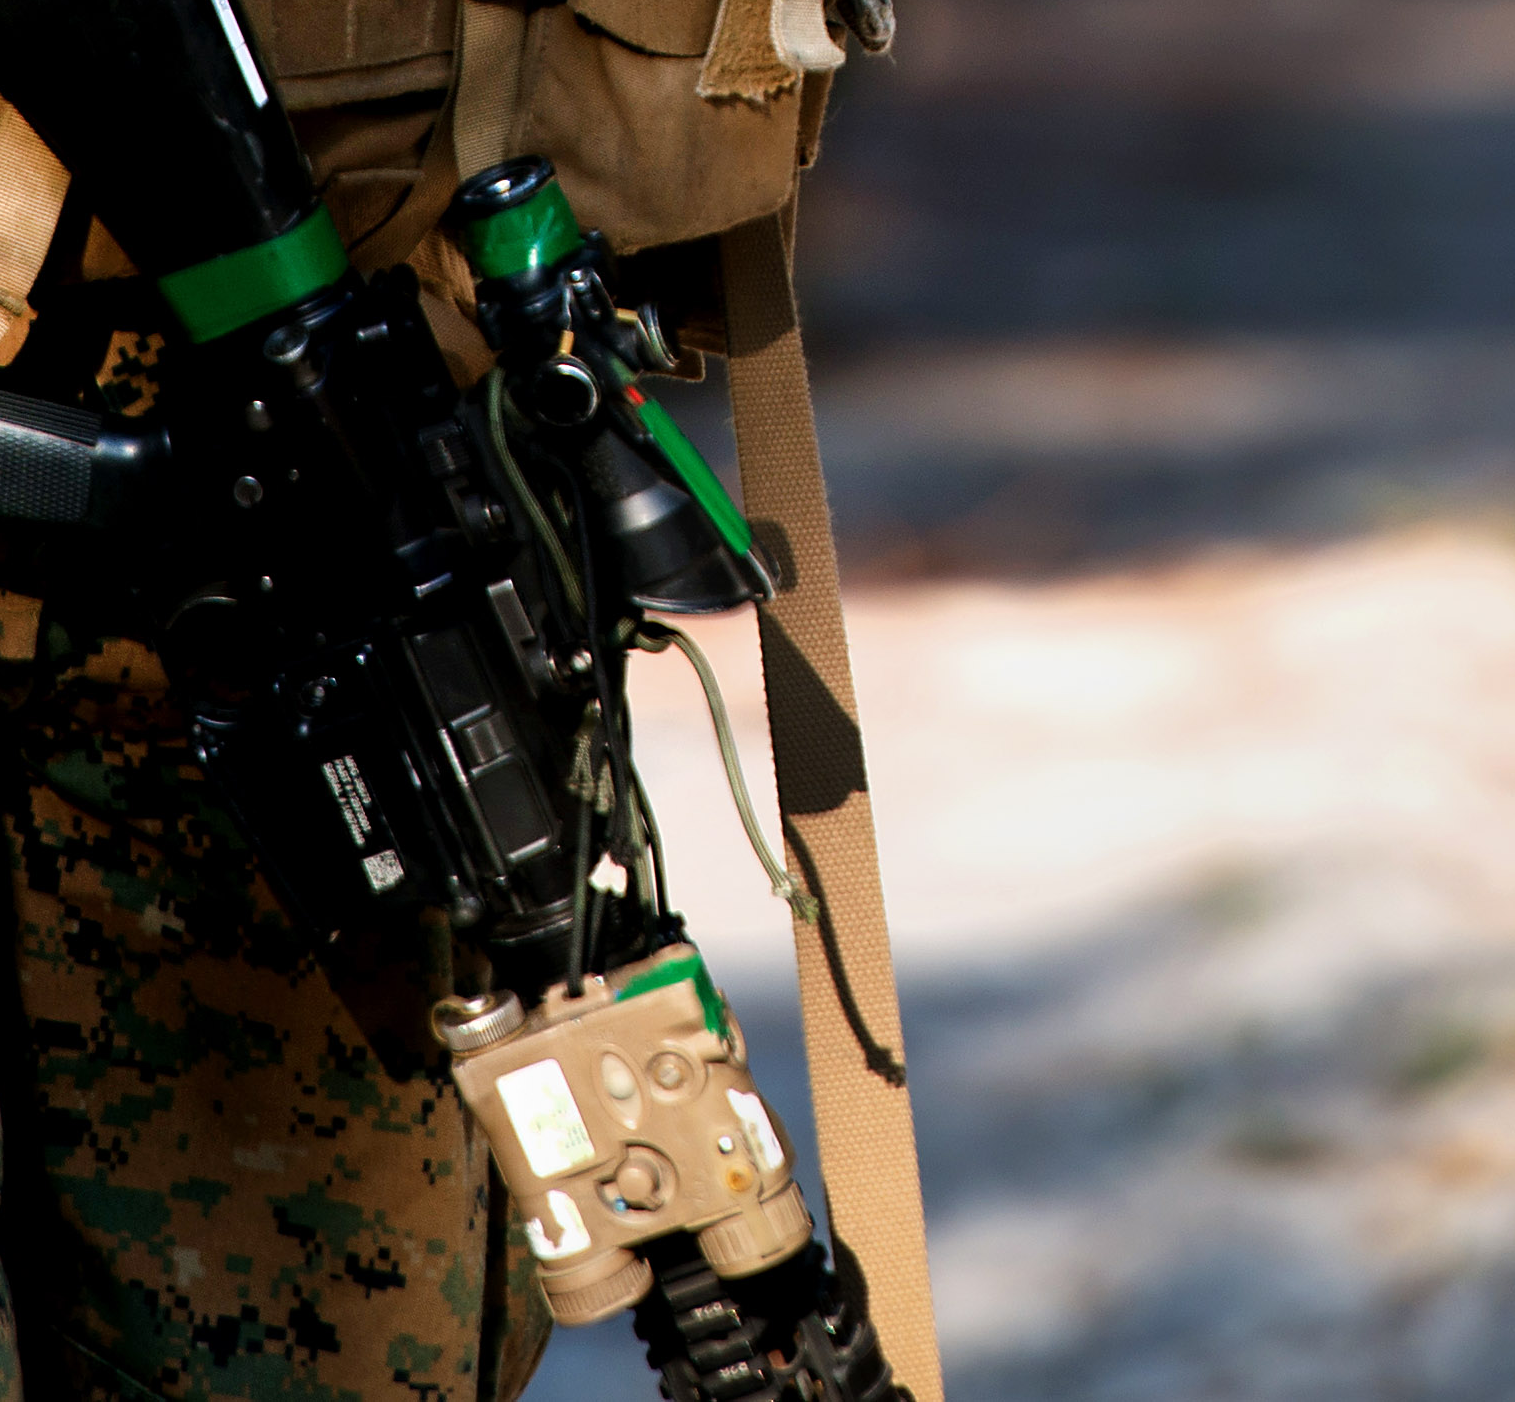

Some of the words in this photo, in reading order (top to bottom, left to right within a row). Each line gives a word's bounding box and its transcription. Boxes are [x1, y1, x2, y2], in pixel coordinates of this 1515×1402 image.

[334, 758, 351, 782] PART
[345, 755, 359, 777] MFG
[323, 762, 342, 798] SERIAL
